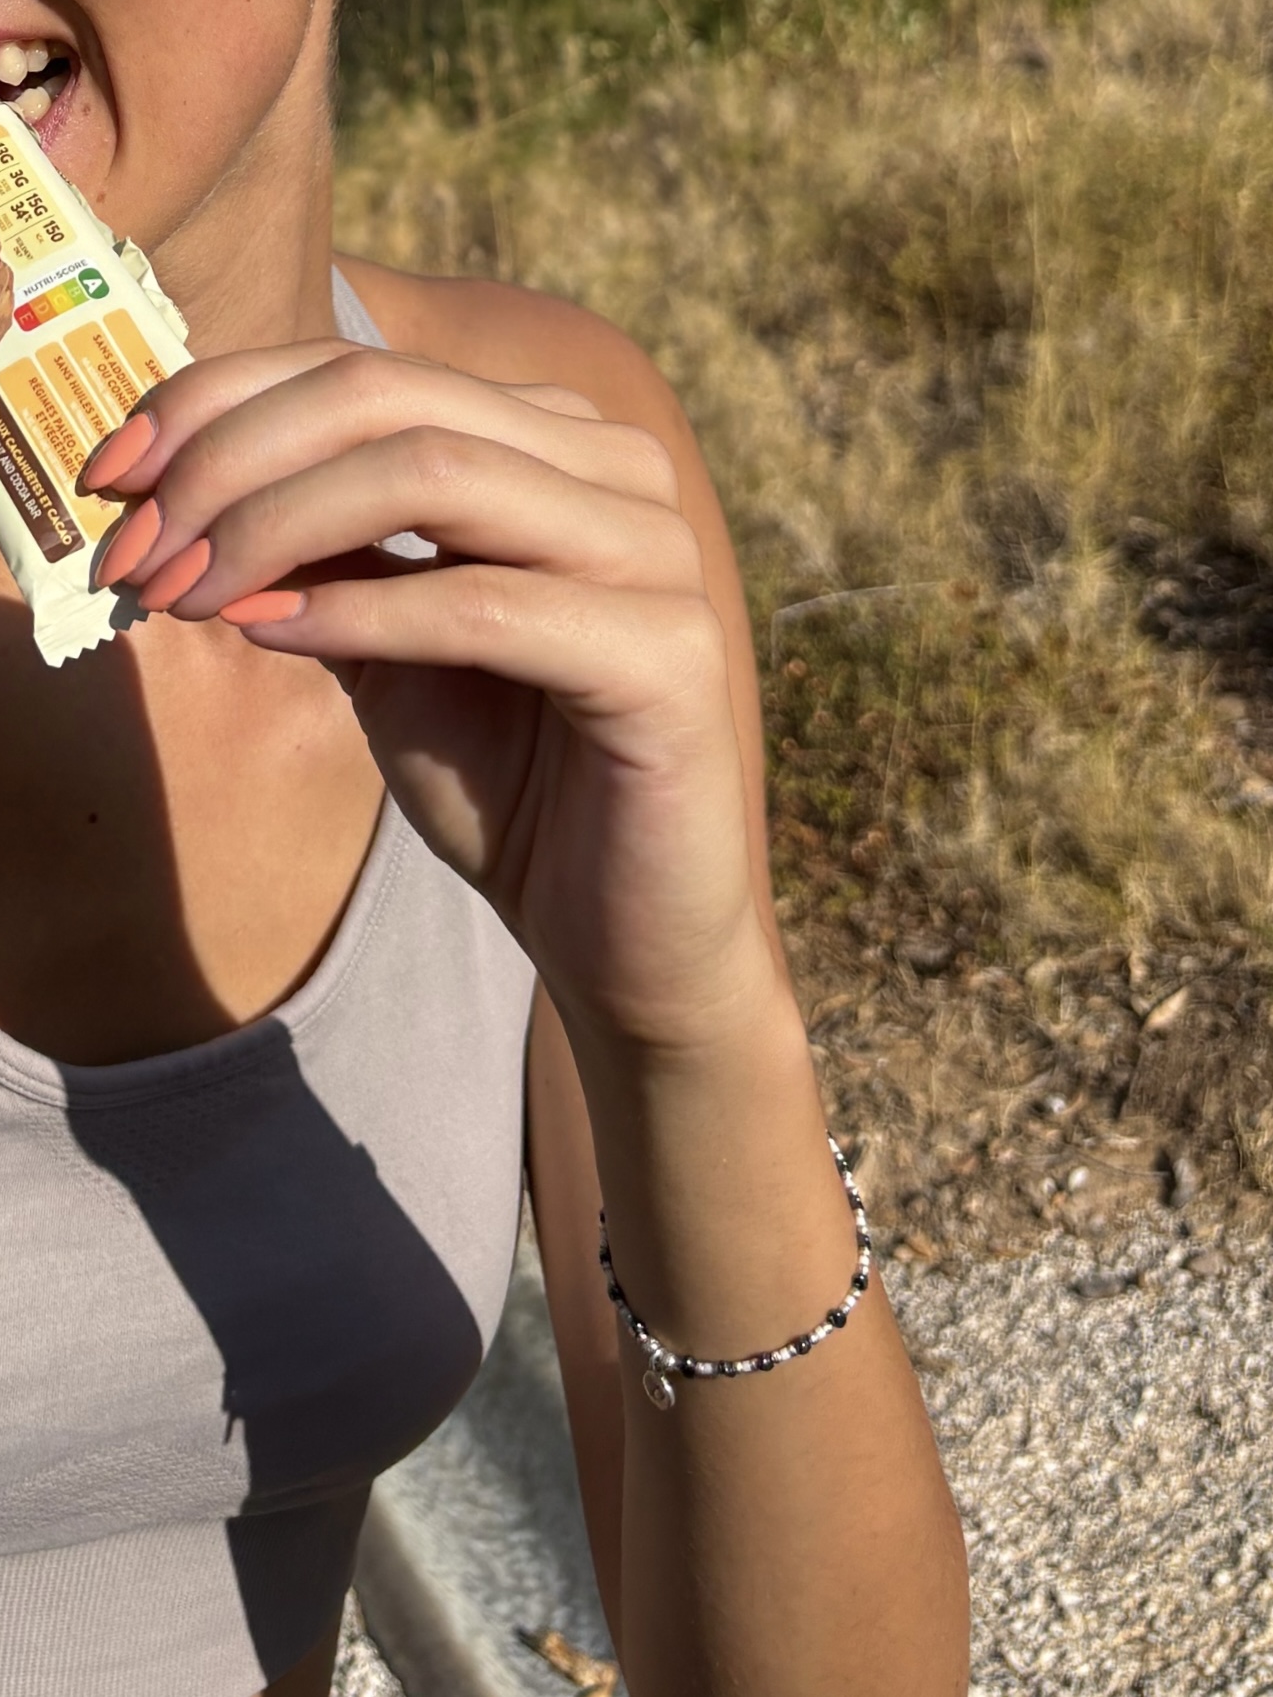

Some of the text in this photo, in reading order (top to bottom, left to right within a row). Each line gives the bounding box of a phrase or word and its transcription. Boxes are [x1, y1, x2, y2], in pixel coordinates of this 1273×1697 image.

[8, 167, 29, 189] 3G
[9, 199, 33, 226] 34%
[24, 191, 48, 218] 15G
[41, 218, 65, 245] 150
[21, 256, 88, 297] NUTRI-SCORE
[81, 271, 106, 295] A
[17, 310, 34, 325] E
[34, 300, 52, 316] D
[91, 332, 114, 361] SANS
[52, 354, 74, 382] SANS
[67, 378, 94, 415] HUILES
[143, 357, 166, 385] SANS
[95, 361, 112, 381] OU
[105, 377, 133, 414] CONSE
[26, 374, 60, 419] RÉGIMES
[50, 414, 81, 454] PALÉO,
[33, 410, 50, 427] ET
[2, 434, 48, 498] CACAHUÈTES
[7, 471, 32, 502] COCOA
[23, 498, 42, 520] BAR
[37, 493, 53, 510] ET
[43, 506, 75, 547] CACAO
